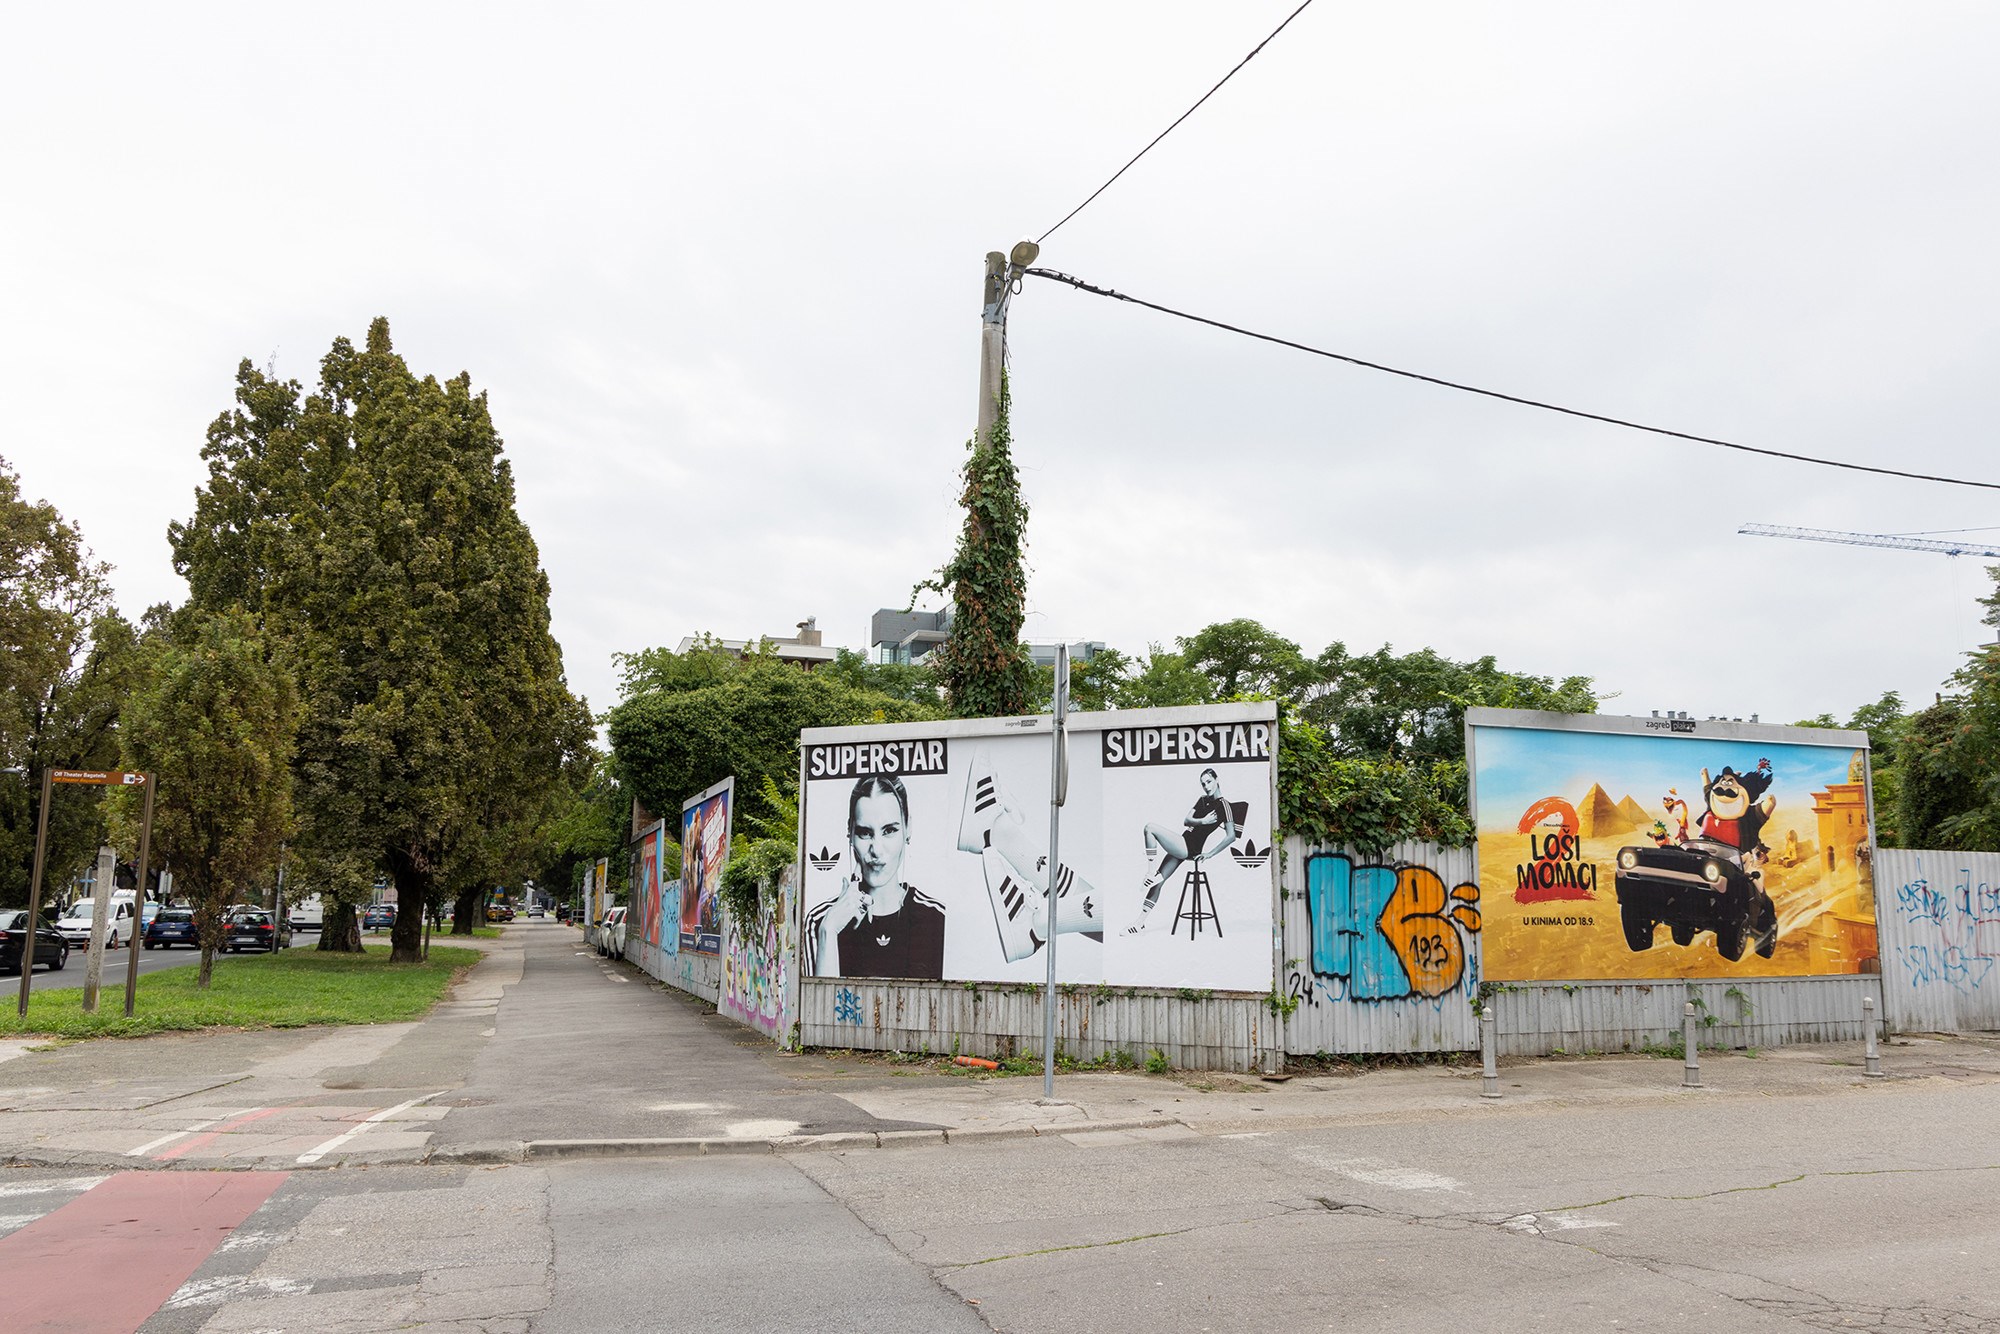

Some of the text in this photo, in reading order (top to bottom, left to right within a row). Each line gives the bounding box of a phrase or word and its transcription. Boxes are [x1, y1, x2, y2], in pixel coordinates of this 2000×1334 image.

[1646, 721, 1670, 730] zagreb
[811, 740, 944, 776] SUPERSTAR
[1106, 723, 1270, 763] SUPERSTAR
[1531, 828, 1580, 861] LOŠI
[1517, 862, 1597, 891] MOMCI
[1523, 917, 1595, 926] U KINIMA OD 18.9.
[1409, 934, 1448, 968] 193
